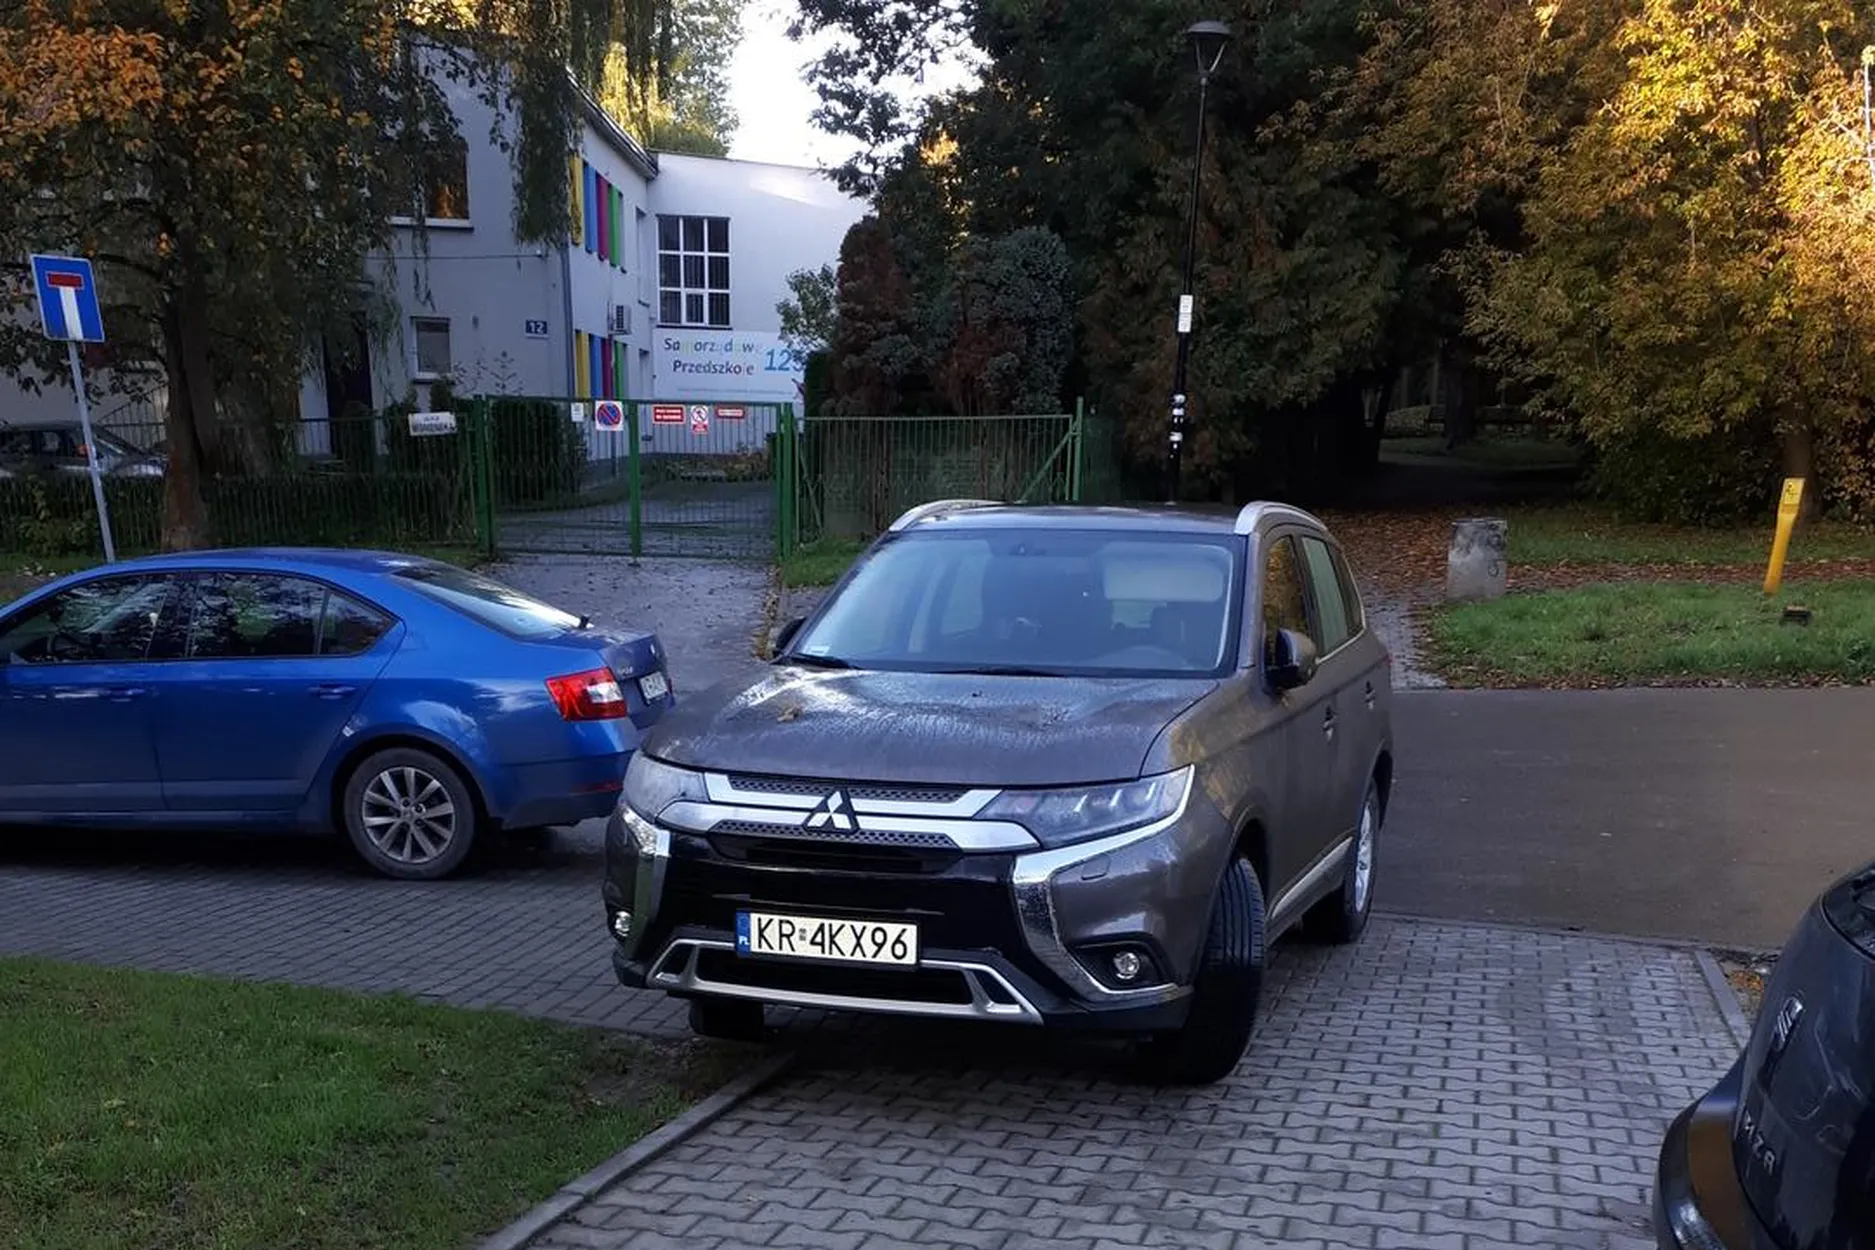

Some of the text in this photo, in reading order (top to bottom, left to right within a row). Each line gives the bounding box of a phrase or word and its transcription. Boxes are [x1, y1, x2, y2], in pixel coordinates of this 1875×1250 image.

[530, 322, 545, 334] 12
[664, 337, 763, 355] Samorządwe
[672, 359, 755, 376] Przedszkole
[738, 935, 750, 945] PL
[757, 916, 908, 960] KR 4KX96
